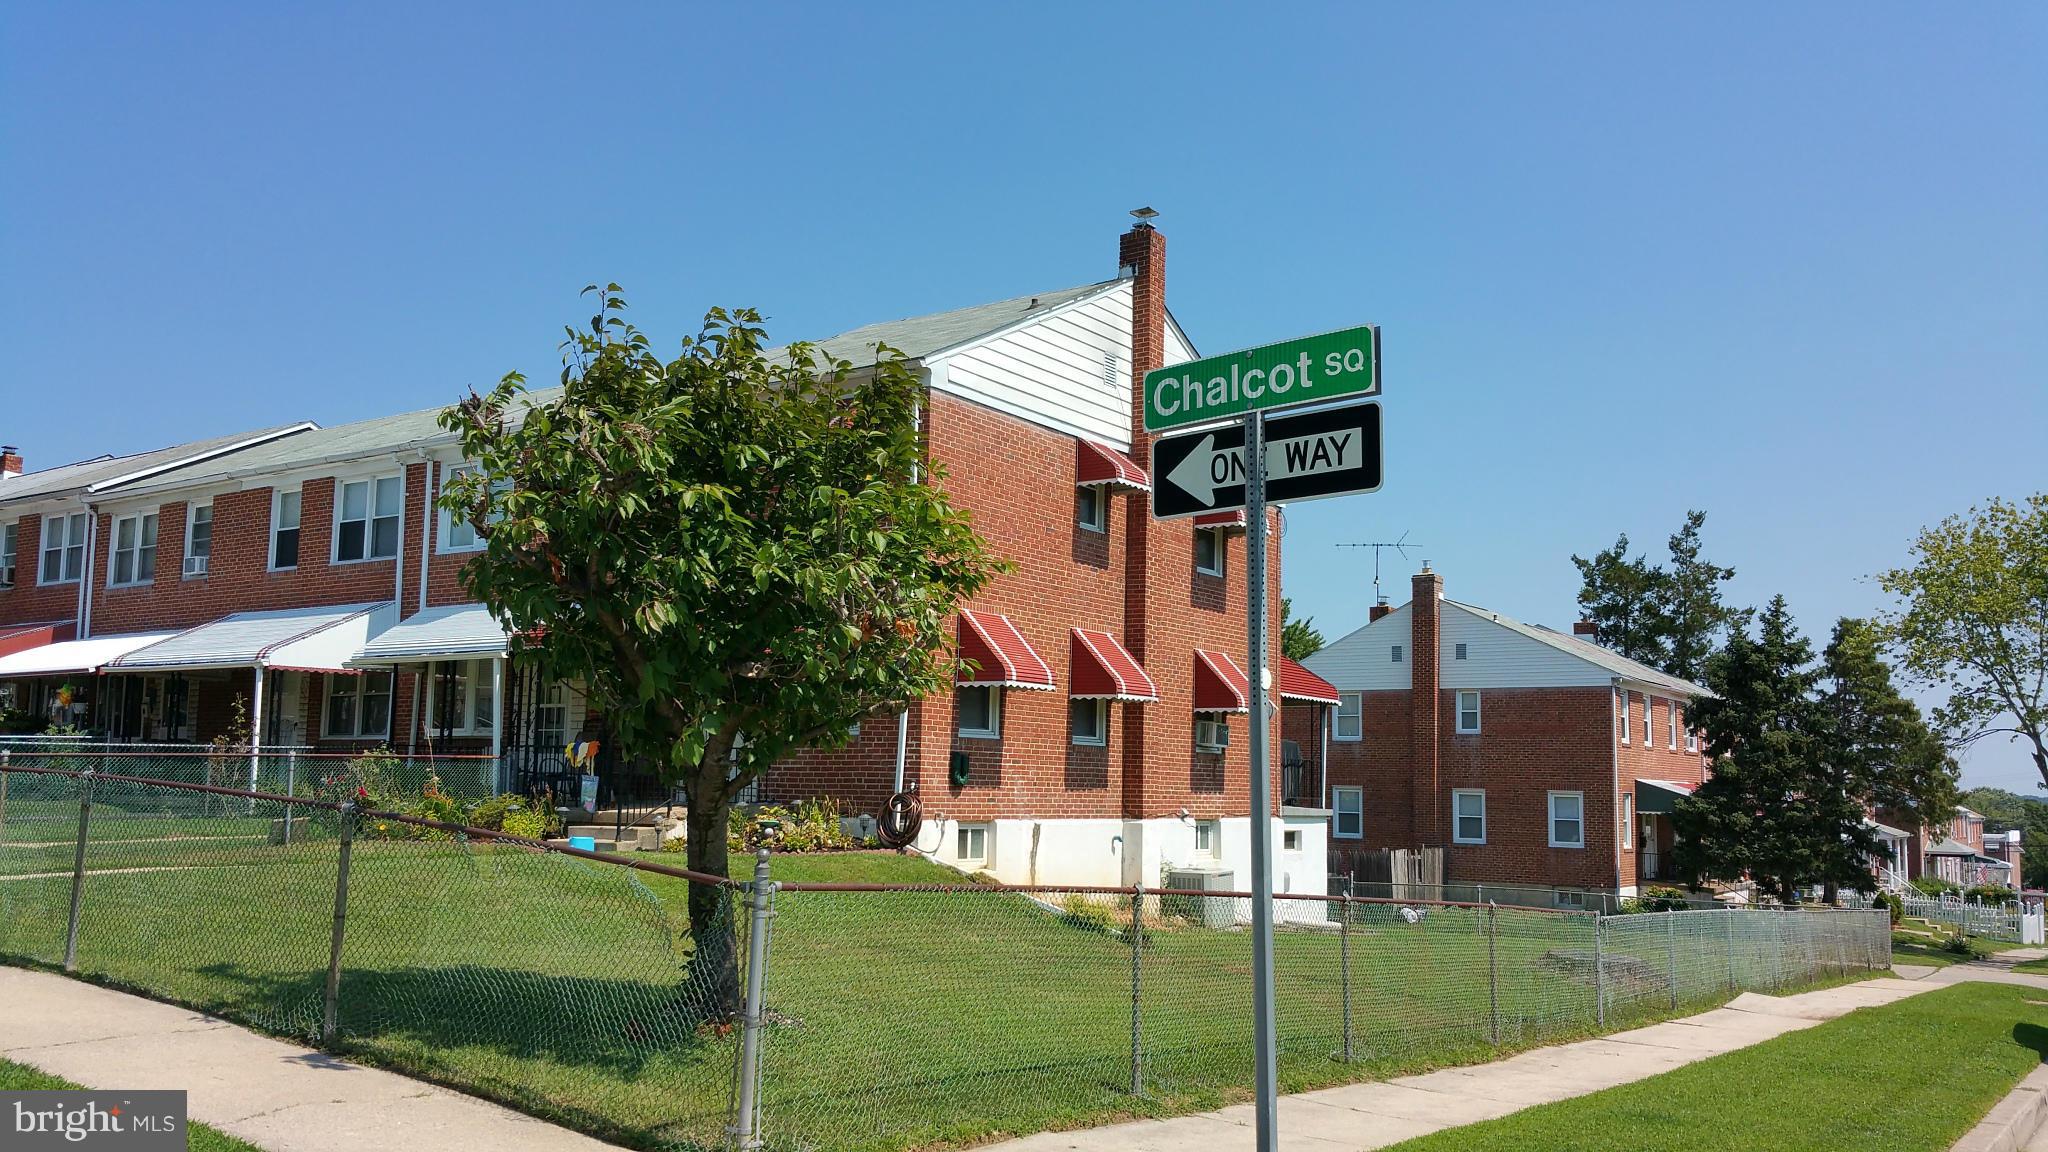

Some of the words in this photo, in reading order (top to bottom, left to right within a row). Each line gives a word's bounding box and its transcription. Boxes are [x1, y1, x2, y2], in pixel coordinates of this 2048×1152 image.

[1154, 352, 1313, 416] Chalcot
[1325, 349, 1364, 376] SQ
[1211, 446, 1269, 484] ON
[1285, 433, 1351, 473] WAY
